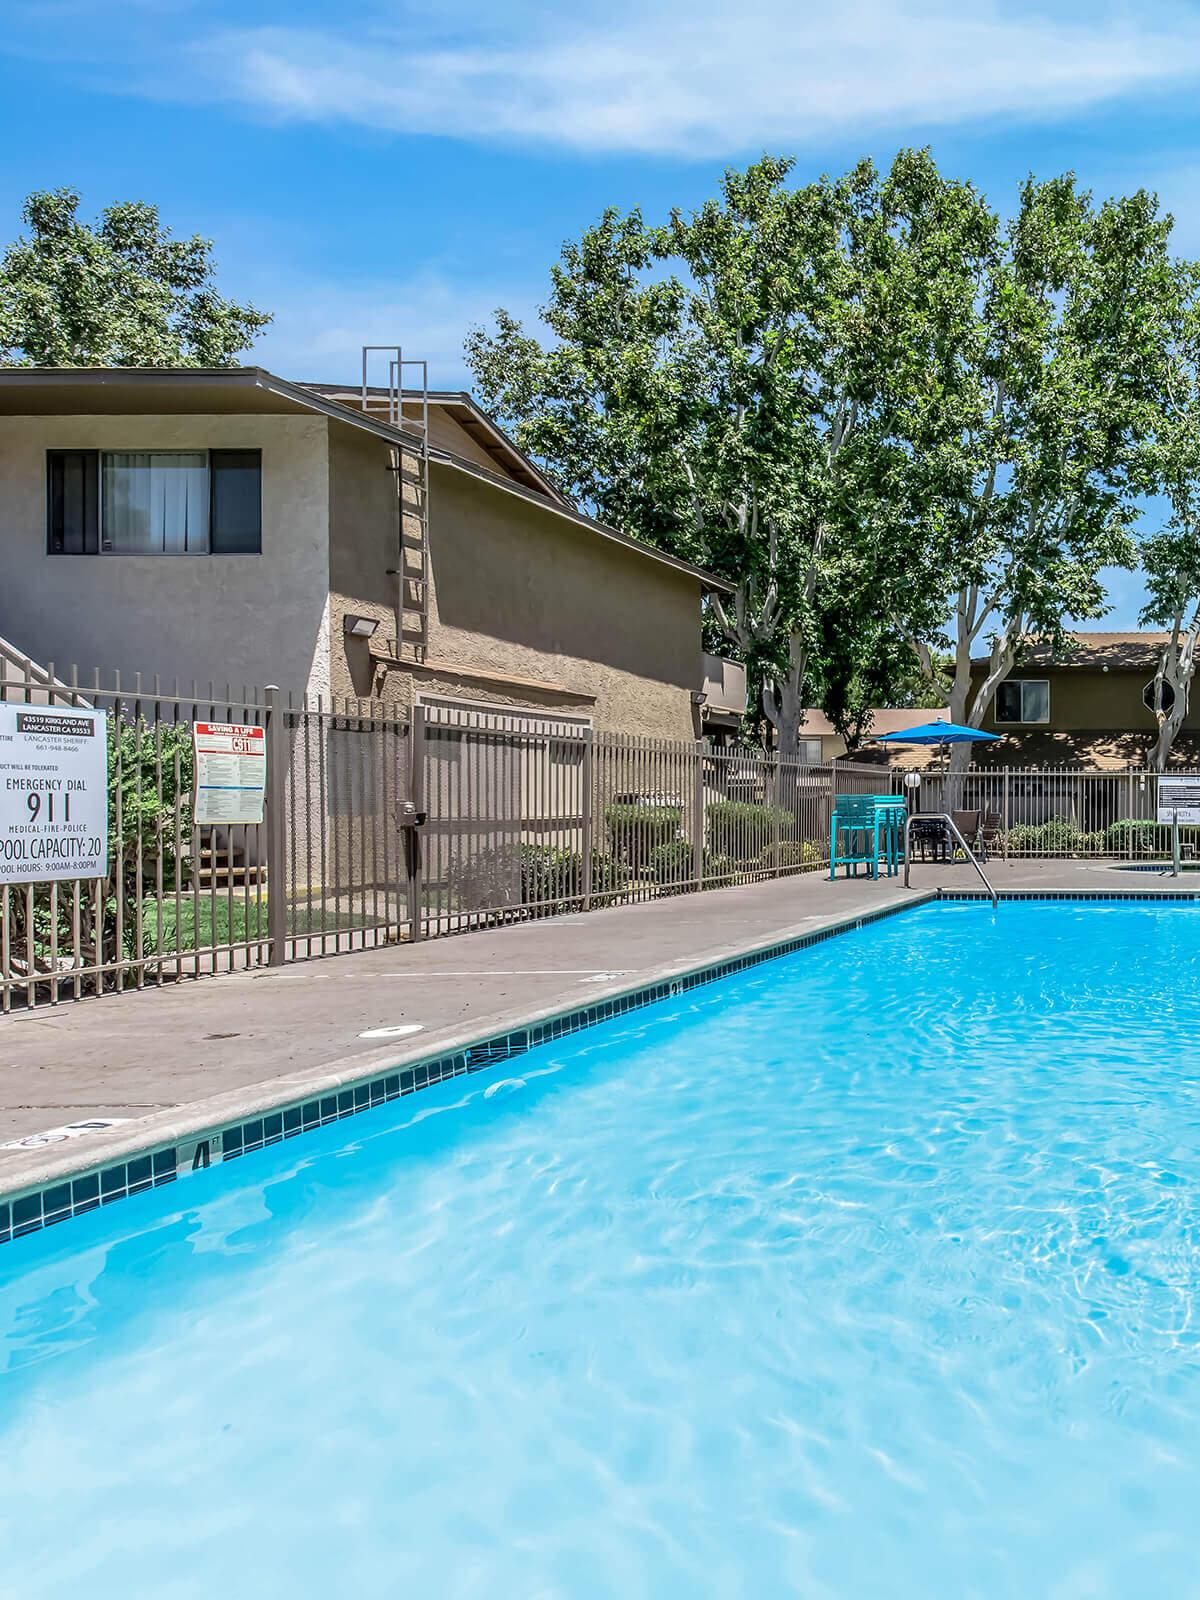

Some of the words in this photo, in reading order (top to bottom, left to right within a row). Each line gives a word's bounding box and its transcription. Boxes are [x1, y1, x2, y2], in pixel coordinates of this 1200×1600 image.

[23, 715, 45, 723] 43519
[46, 717, 77, 726] KIRKLAND
[23, 723, 61, 733] LANCASTER
[208, 725, 233, 733] SAVING
[24, 735, 62, 743] LANCASTER
[6, 778, 62, 791] EMERGENCY
[67, 779, 87, 791] DIAL
[27, 792, 70, 822] 911
[31, 837, 86, 859] CAPACITY:
[87, 837, 101, 857] 20
[0, 864, 15, 874] OOL
[16, 862, 43, 873] HOURS:
[45, 860, 97, 871] 9:00AM-8:00PM
[212, 1135, 220, 1145] FT
